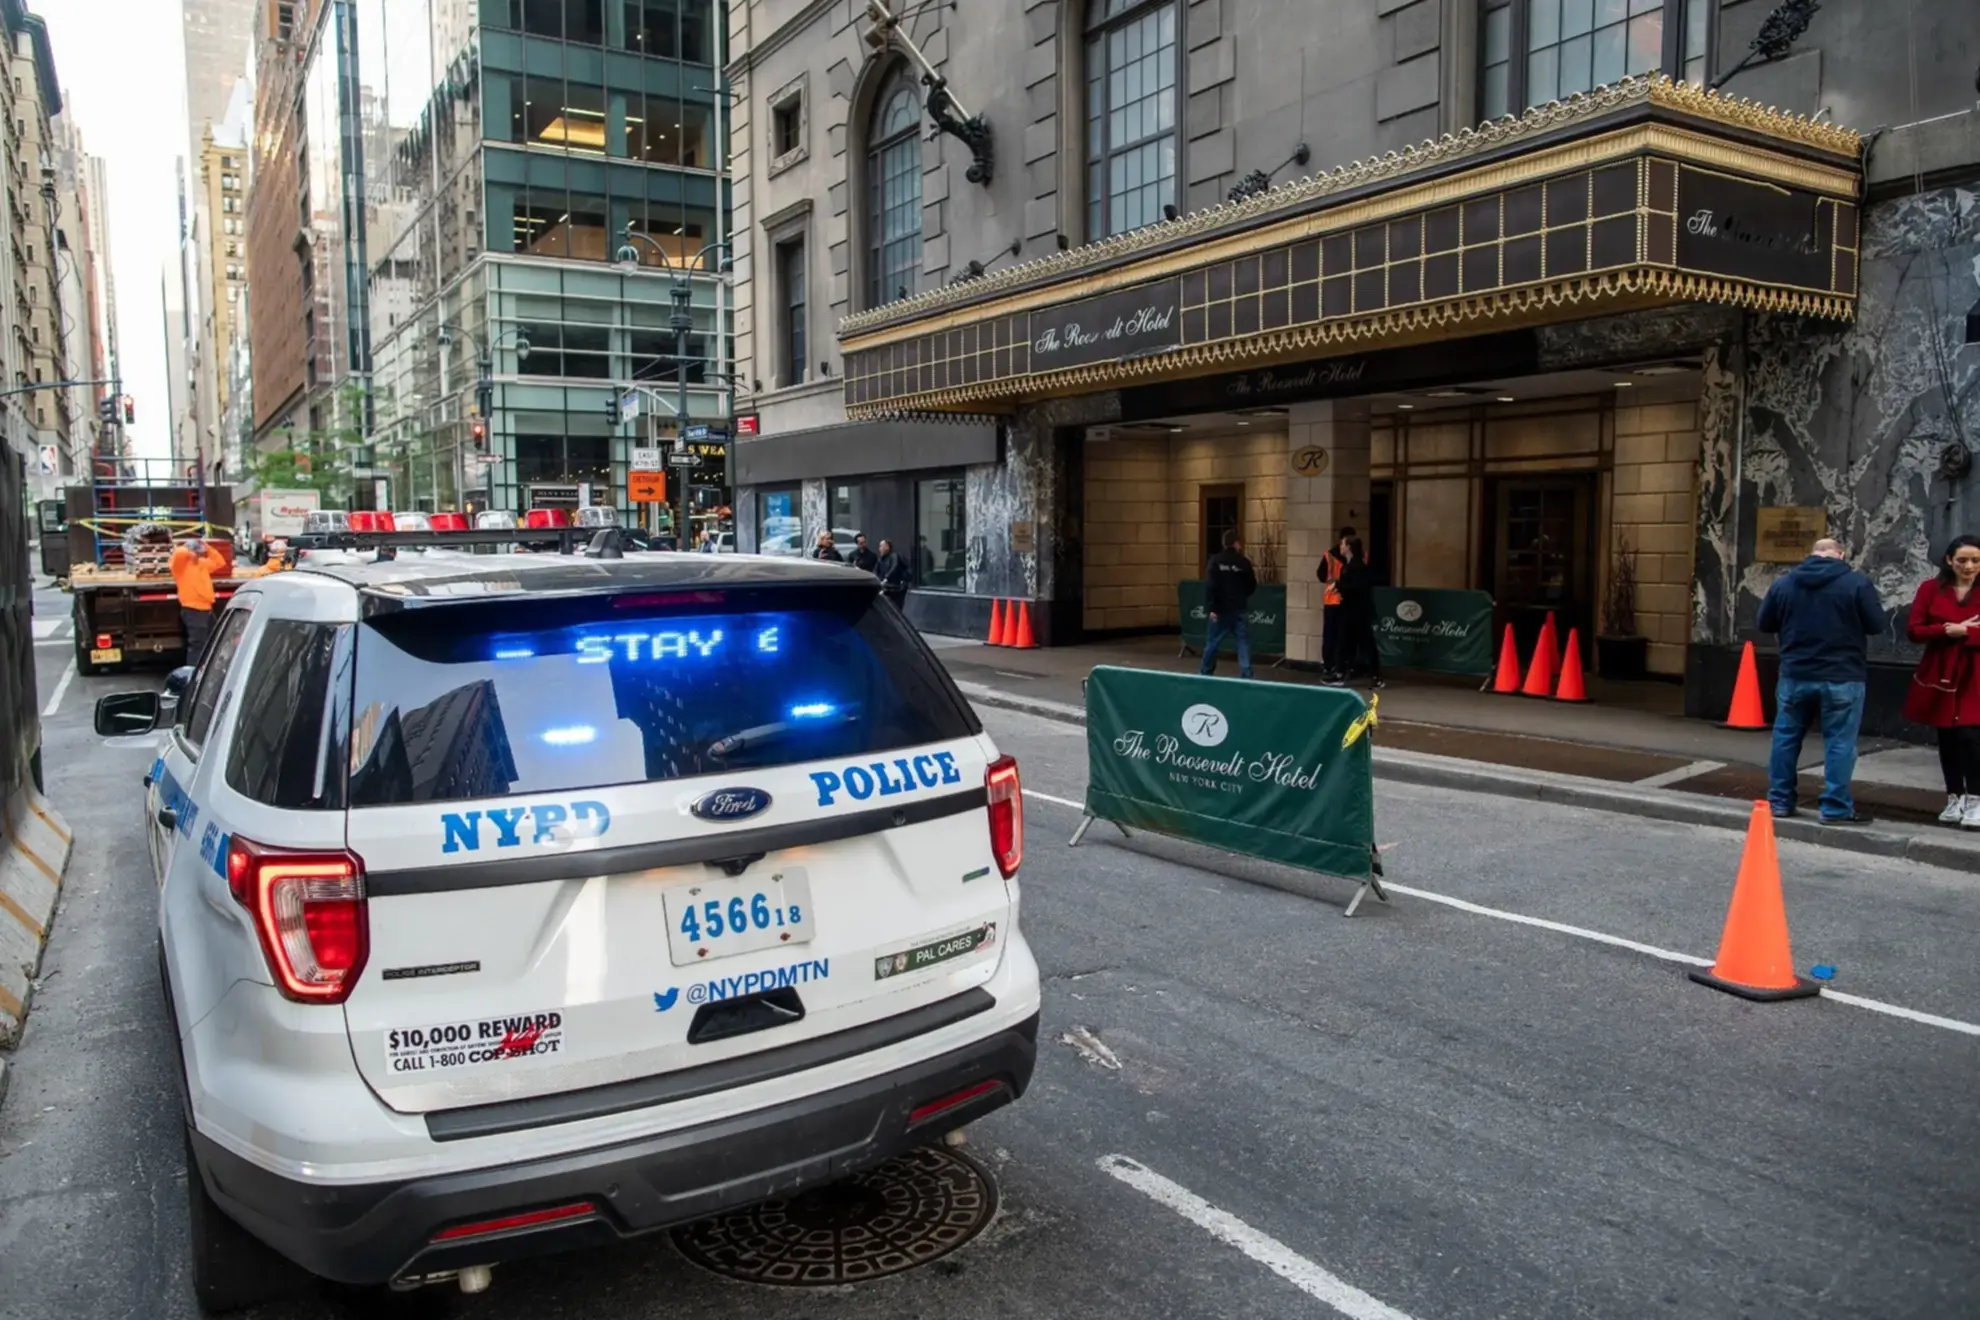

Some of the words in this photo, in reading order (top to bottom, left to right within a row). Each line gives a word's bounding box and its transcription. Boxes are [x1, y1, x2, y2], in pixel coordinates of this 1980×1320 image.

[1687, 209, 1718, 237] The
[1035, 328, 1060, 354] The
[1126, 306, 1174, 336] Hotel
[1320, 361, 1366, 385] Hotel
[1296, 450, 1323, 471] R
[1431, 620, 1471, 638] Hotel
[576, 629, 724, 664] STAY
[1190, 712, 1220, 738] R
[1113, 730, 1151, 760] The
[1155, 733, 1245, 777] Roosevelt
[1247, 751, 1323, 790] Hotel
[809, 751, 961, 807] POLICE
[1169, 772, 1189, 784] NEW
[1192, 776, 1218, 790] YORK
[1220, 781, 1244, 794] CITY
[711, 789, 757, 816] Ford
[441, 801, 611, 853] NYPD
[680, 893, 770, 943] 4566
[775, 905, 802, 926] 18
[916, 949, 936, 964] PAL
[938, 936, 972, 957] CARES
[686, 958, 829, 1004] @NYPDMTN
[389, 1024, 471, 1051] $10,000
[478, 1013, 562, 1038] REWARD
[394, 1057, 425, 1072] CALL
[429, 1052, 465, 1068] 1-800
